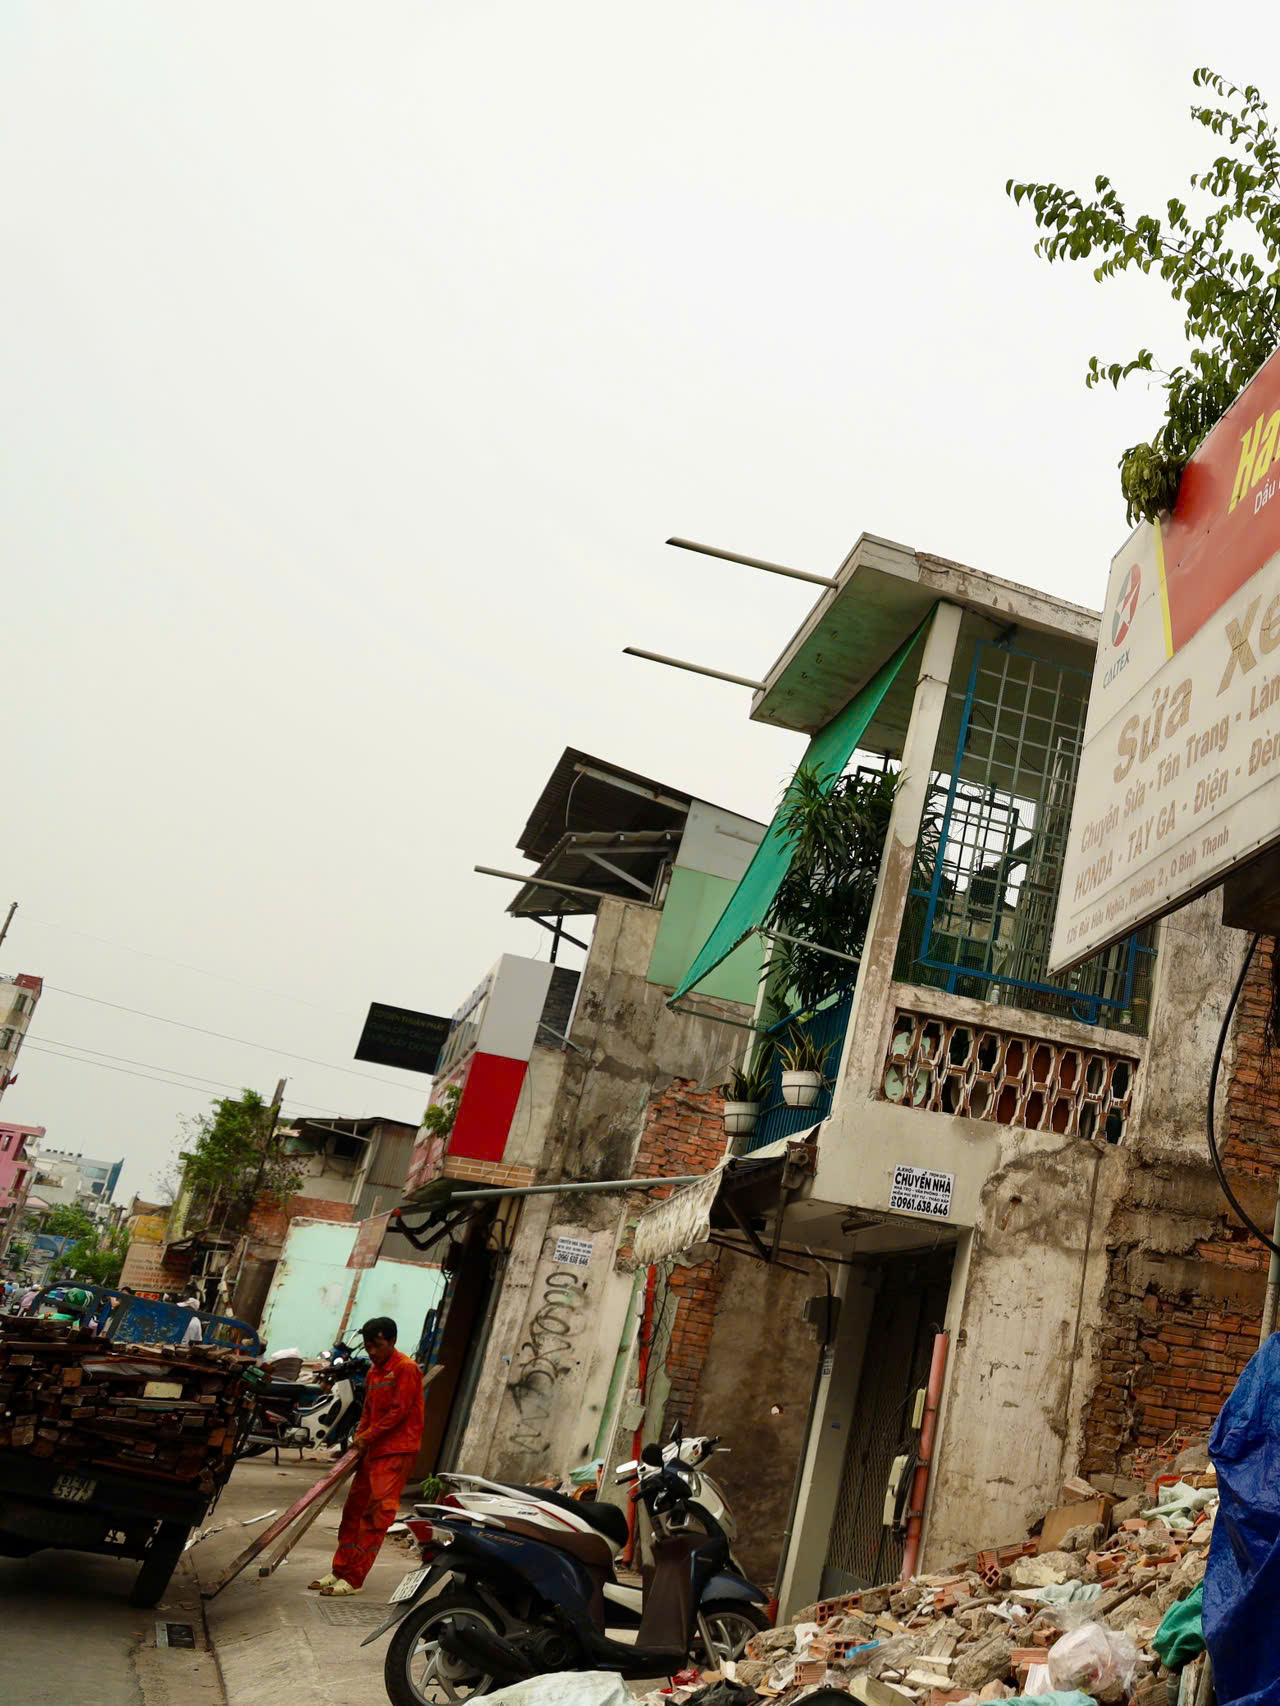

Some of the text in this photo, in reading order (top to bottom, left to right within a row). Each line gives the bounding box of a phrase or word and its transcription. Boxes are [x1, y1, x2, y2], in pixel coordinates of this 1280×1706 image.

[1254, 478, 1276, 515] Dầu
[1102, 648, 1131, 689] CALTEX
[1081, 803, 1120, 853] Chuyên
[1186, 714, 1230, 769] Trang
[1074, 849, 1114, 902] HONDA
[1128, 816, 1154, 863] TAY
[1156, 798, 1176, 841] GA
[1194, 768, 1230, 815] Điện
[1202, 826, 1230, 858] Thạnh
[895, 1171, 951, 1194] CHUYỂN NHÀ
[896, 1196, 948, 1215] 0961.638.646
